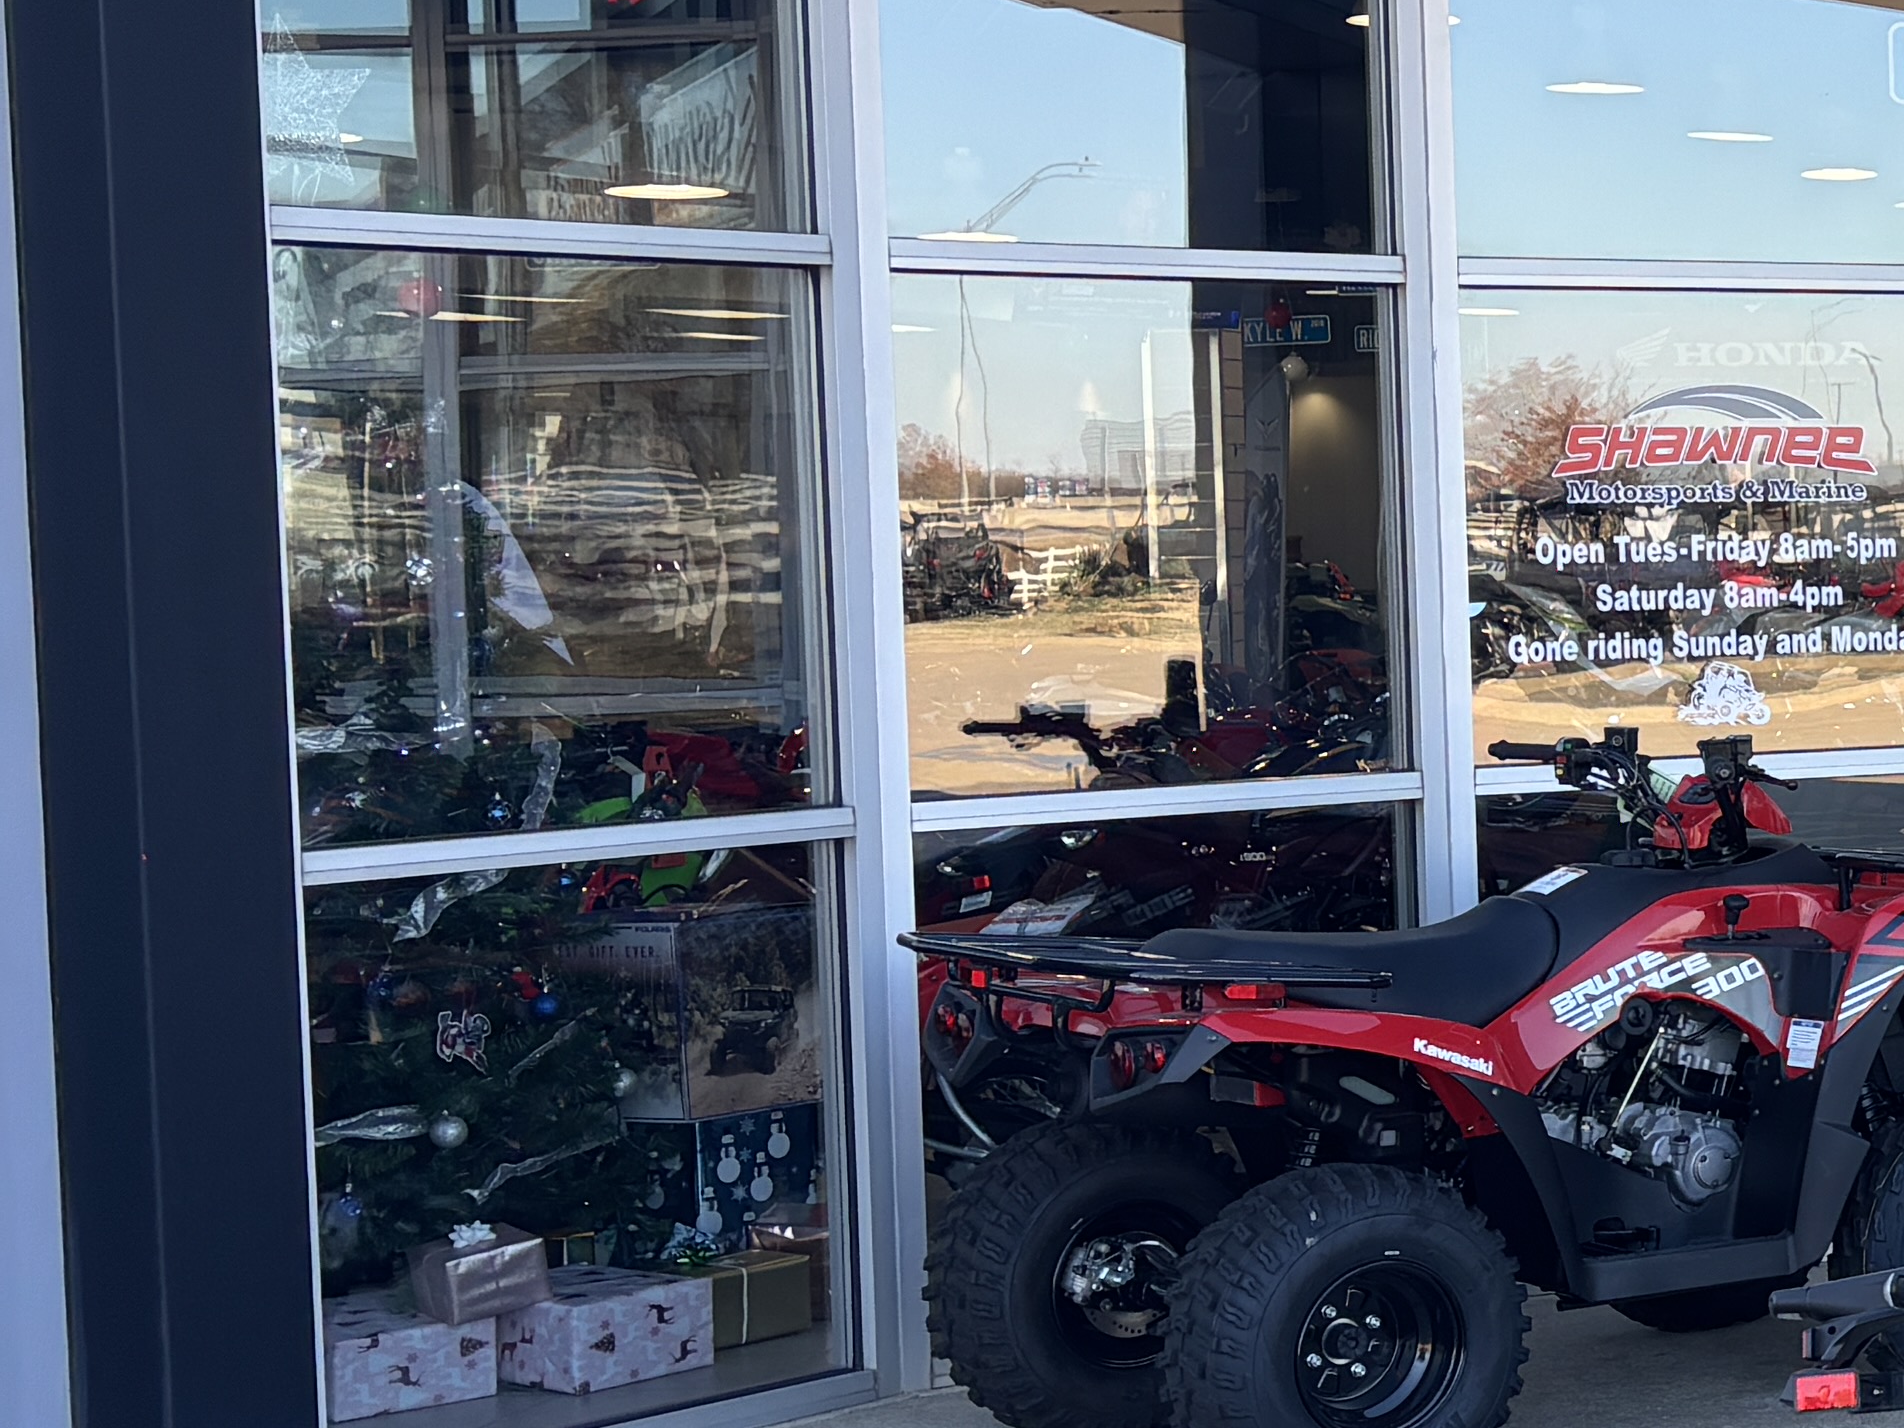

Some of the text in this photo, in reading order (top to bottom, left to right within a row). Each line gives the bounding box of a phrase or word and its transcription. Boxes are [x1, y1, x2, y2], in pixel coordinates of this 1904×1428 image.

[1672, 339, 1871, 368] HONDA
[1566, 478, 1867, 507] Motorsports & Marine
[1535, 536, 1605, 572] Open
[1613, 532, 1770, 568] Tues-Friday
[1596, 581, 1843, 618] Saturday 8am-4pm
[1508, 637, 1579, 664] Gone
[1587, 633, 1664, 666] riding
[1672, 628, 1768, 663] Sunday
[1775, 627, 1826, 655] and
[1549, 950, 1669, 1016] BRUTE
[1691, 957, 1766, 1000] 300
[1412, 1037, 1494, 1078] Kawasaki
